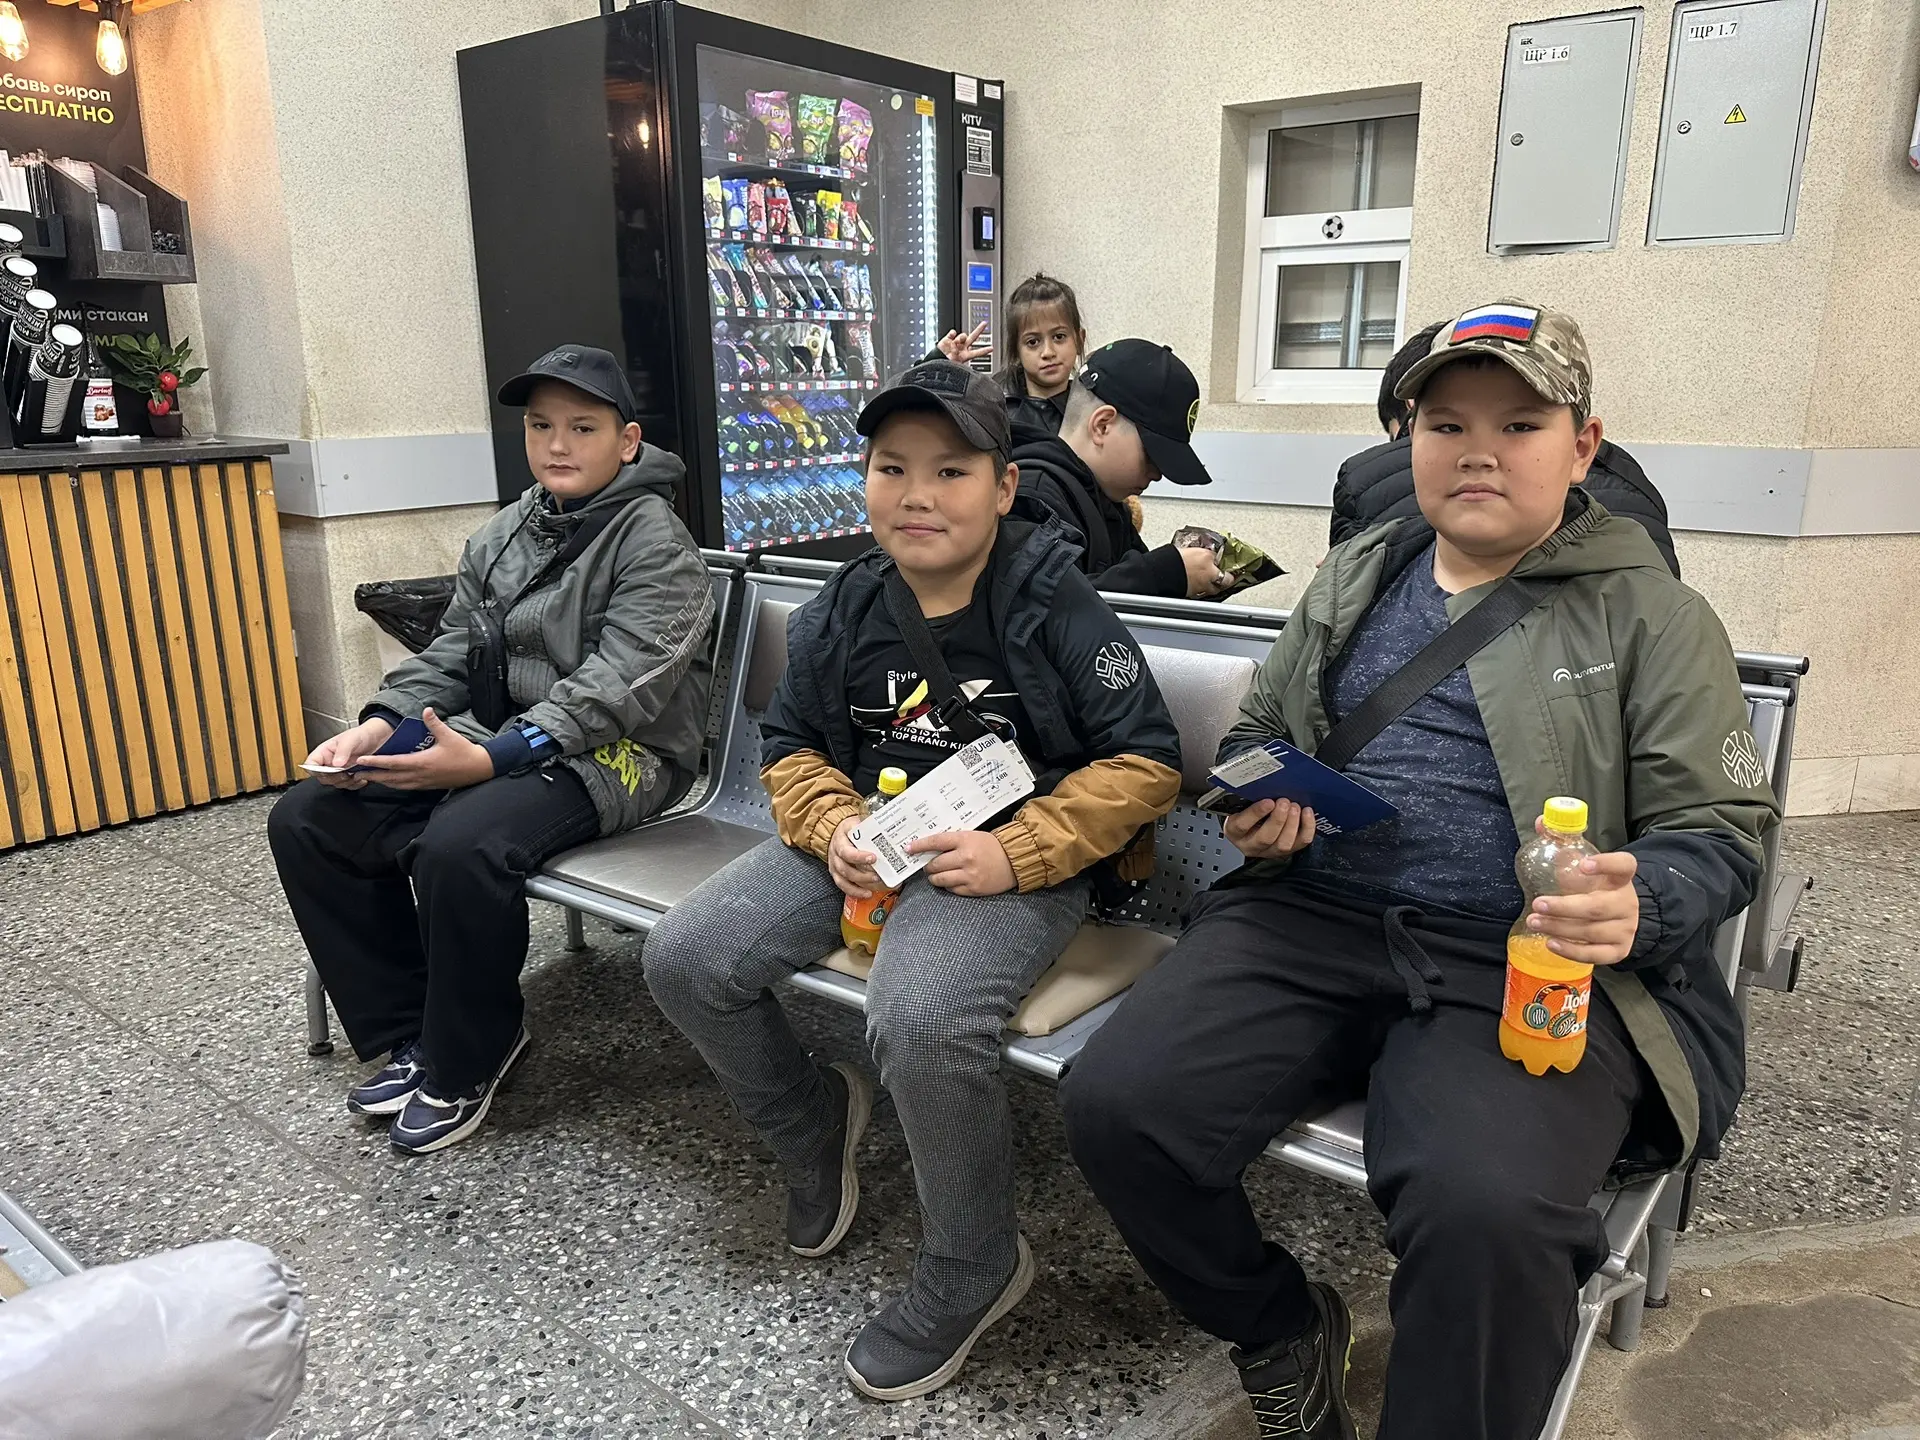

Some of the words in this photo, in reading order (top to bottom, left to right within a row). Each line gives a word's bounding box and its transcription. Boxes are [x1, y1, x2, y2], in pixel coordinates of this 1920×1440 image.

[1719, 22, 1738, 36] 1.7
[53, 83, 111, 102] сироп
[86, 310, 149, 322] стакан
[888, 671, 918, 682] Style
[1573, 662, 1615, 679] OUTVENTUR
[891, 730, 910, 740] TOP
[910, 735, 948, 748] BRAND
[932, 730, 940, 738] A
[973, 737, 997, 753] Utair
